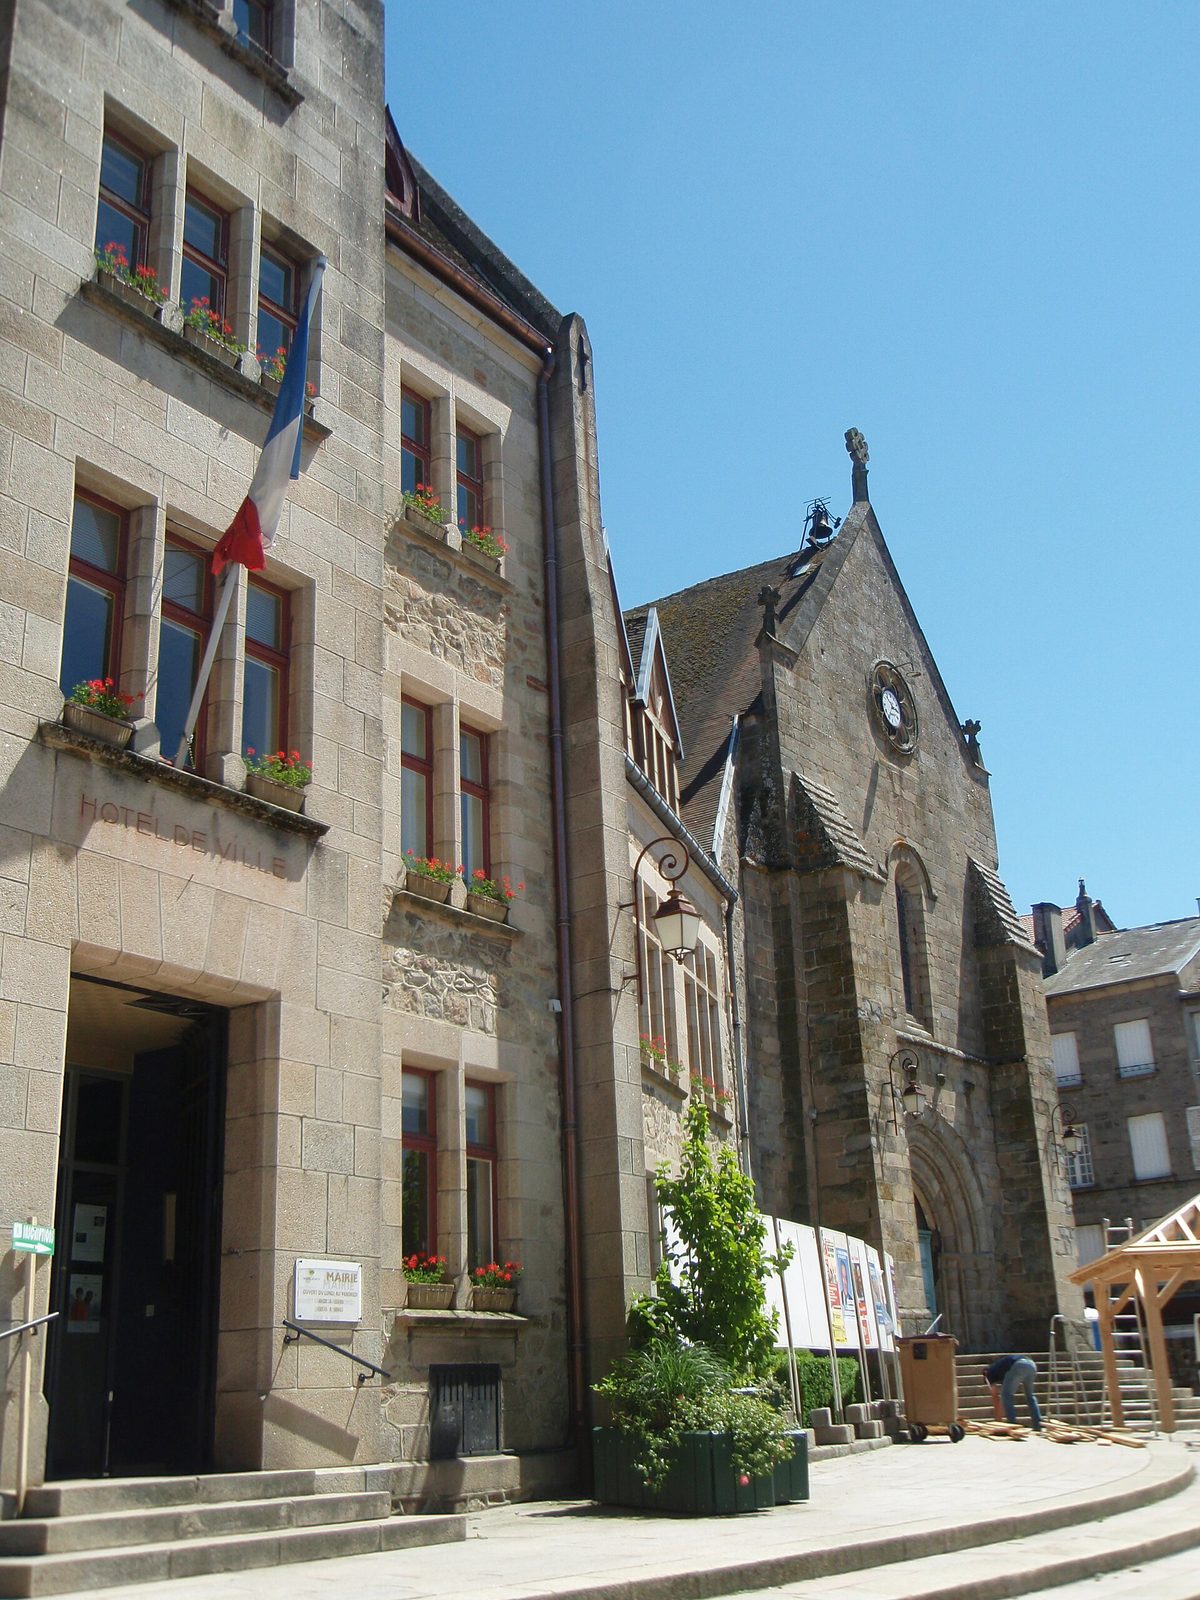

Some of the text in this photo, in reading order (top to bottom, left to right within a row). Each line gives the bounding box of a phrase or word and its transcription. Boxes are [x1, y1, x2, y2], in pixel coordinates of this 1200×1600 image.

[81, 793, 286, 880] HOTEL DE VILLE
[326, 1271, 358, 1283] MAIRIE
